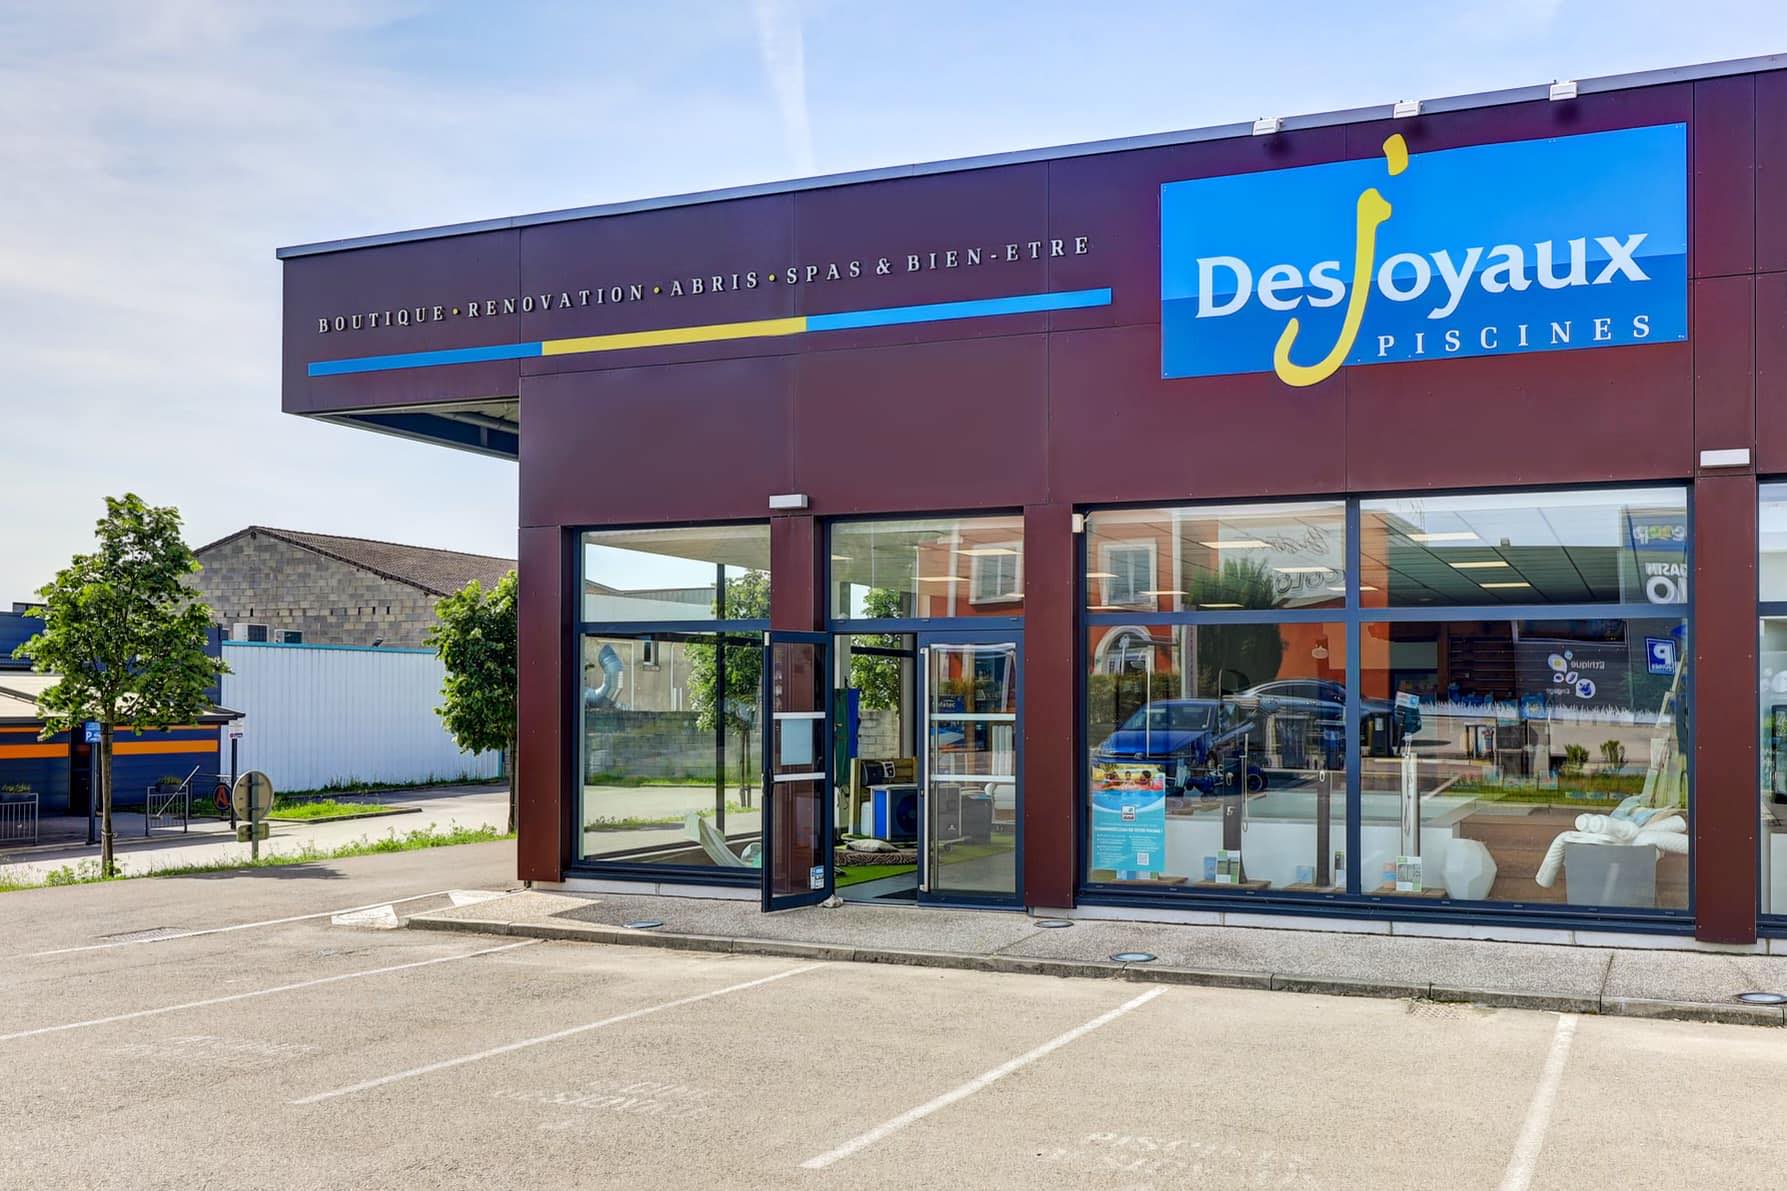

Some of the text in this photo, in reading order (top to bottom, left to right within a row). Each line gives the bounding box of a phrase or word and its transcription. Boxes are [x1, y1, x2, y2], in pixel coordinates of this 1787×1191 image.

[318, 236, 1089, 334] BOUTIQUE RENOVATION ABRIS SPAS & BIEN-ETRE
[1377, 314, 1651, 357] PISCINES
